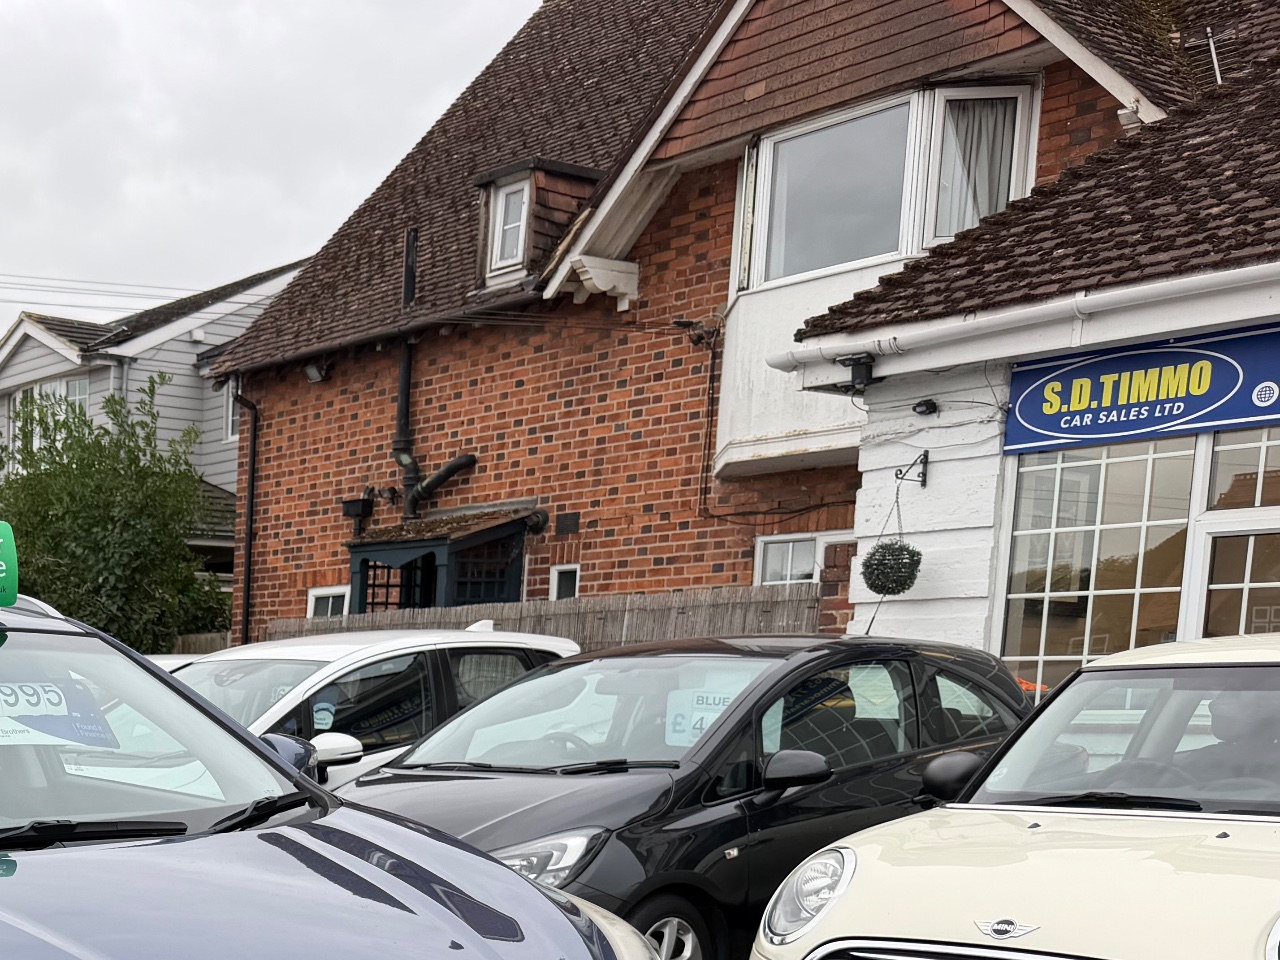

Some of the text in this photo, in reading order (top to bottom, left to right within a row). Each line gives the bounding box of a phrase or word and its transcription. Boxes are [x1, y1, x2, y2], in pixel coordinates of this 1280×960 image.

[1042, 359, 1213, 415] S.D.TIMMO
[1060, 402, 1185, 429] CAR SALES LTD
[696, 695, 730, 707] BLUE
[671, 713, 686, 734] £
[992, 923, 1015, 931] MINI
